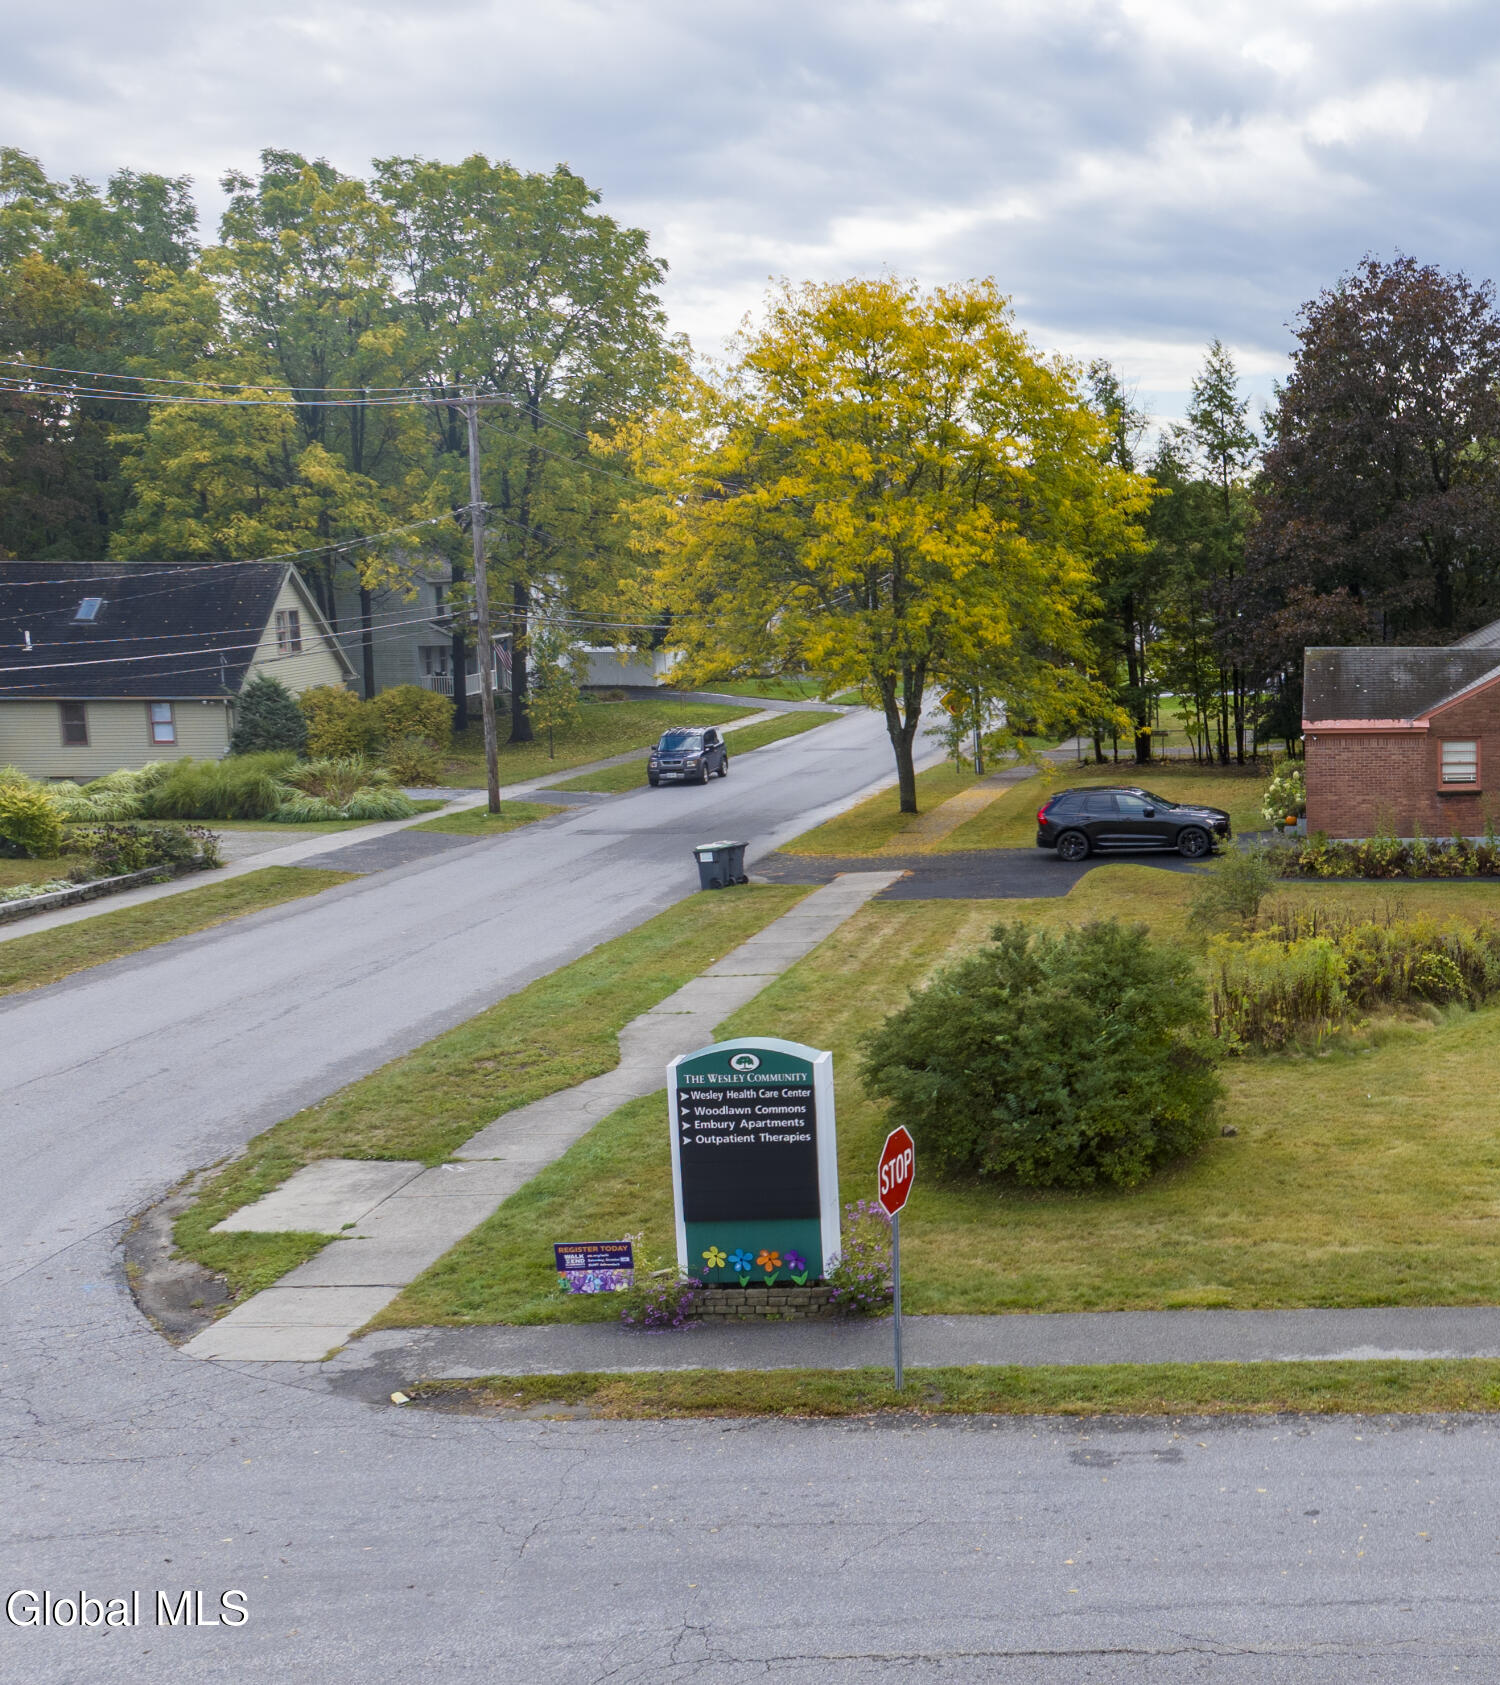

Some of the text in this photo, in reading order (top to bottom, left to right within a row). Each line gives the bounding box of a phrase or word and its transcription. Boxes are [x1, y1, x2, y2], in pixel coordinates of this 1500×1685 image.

[684, 1072, 808, 1084] THE WESLEY COMMUNITY
[690, 1088, 812, 1101] Wesley Health Care Center
[694, 1104, 807, 1116] Woodlawn Commons
[694, 1118, 805, 1131] Embury Apartments
[695, 1132, 812, 1145] Outpatient Therapies
[881, 1148, 912, 1195] STOP
